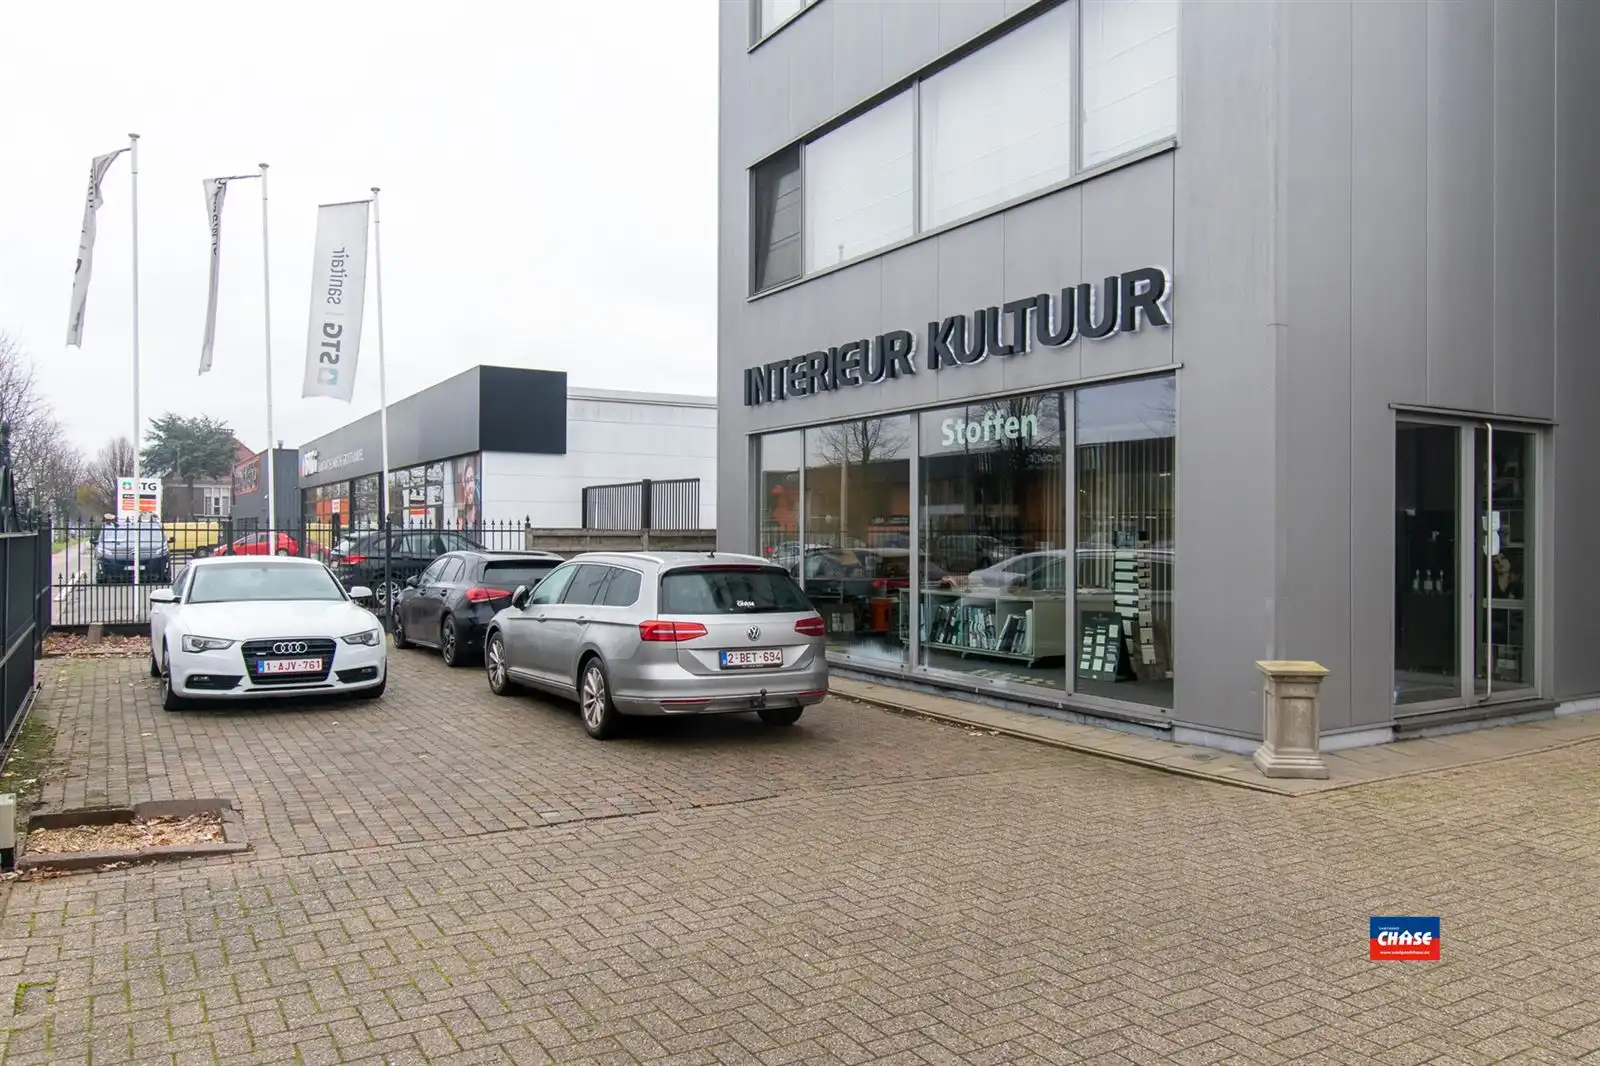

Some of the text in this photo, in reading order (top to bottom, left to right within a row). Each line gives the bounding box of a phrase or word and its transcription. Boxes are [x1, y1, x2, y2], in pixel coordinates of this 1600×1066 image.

[744, 266, 1172, 407] INTERIEUR KULTUUR
[941, 408, 1038, 446] Stoffen
[266, 660, 320, 672] 1-AJV-761
[728, 651, 781, 664] 2-BET-694
